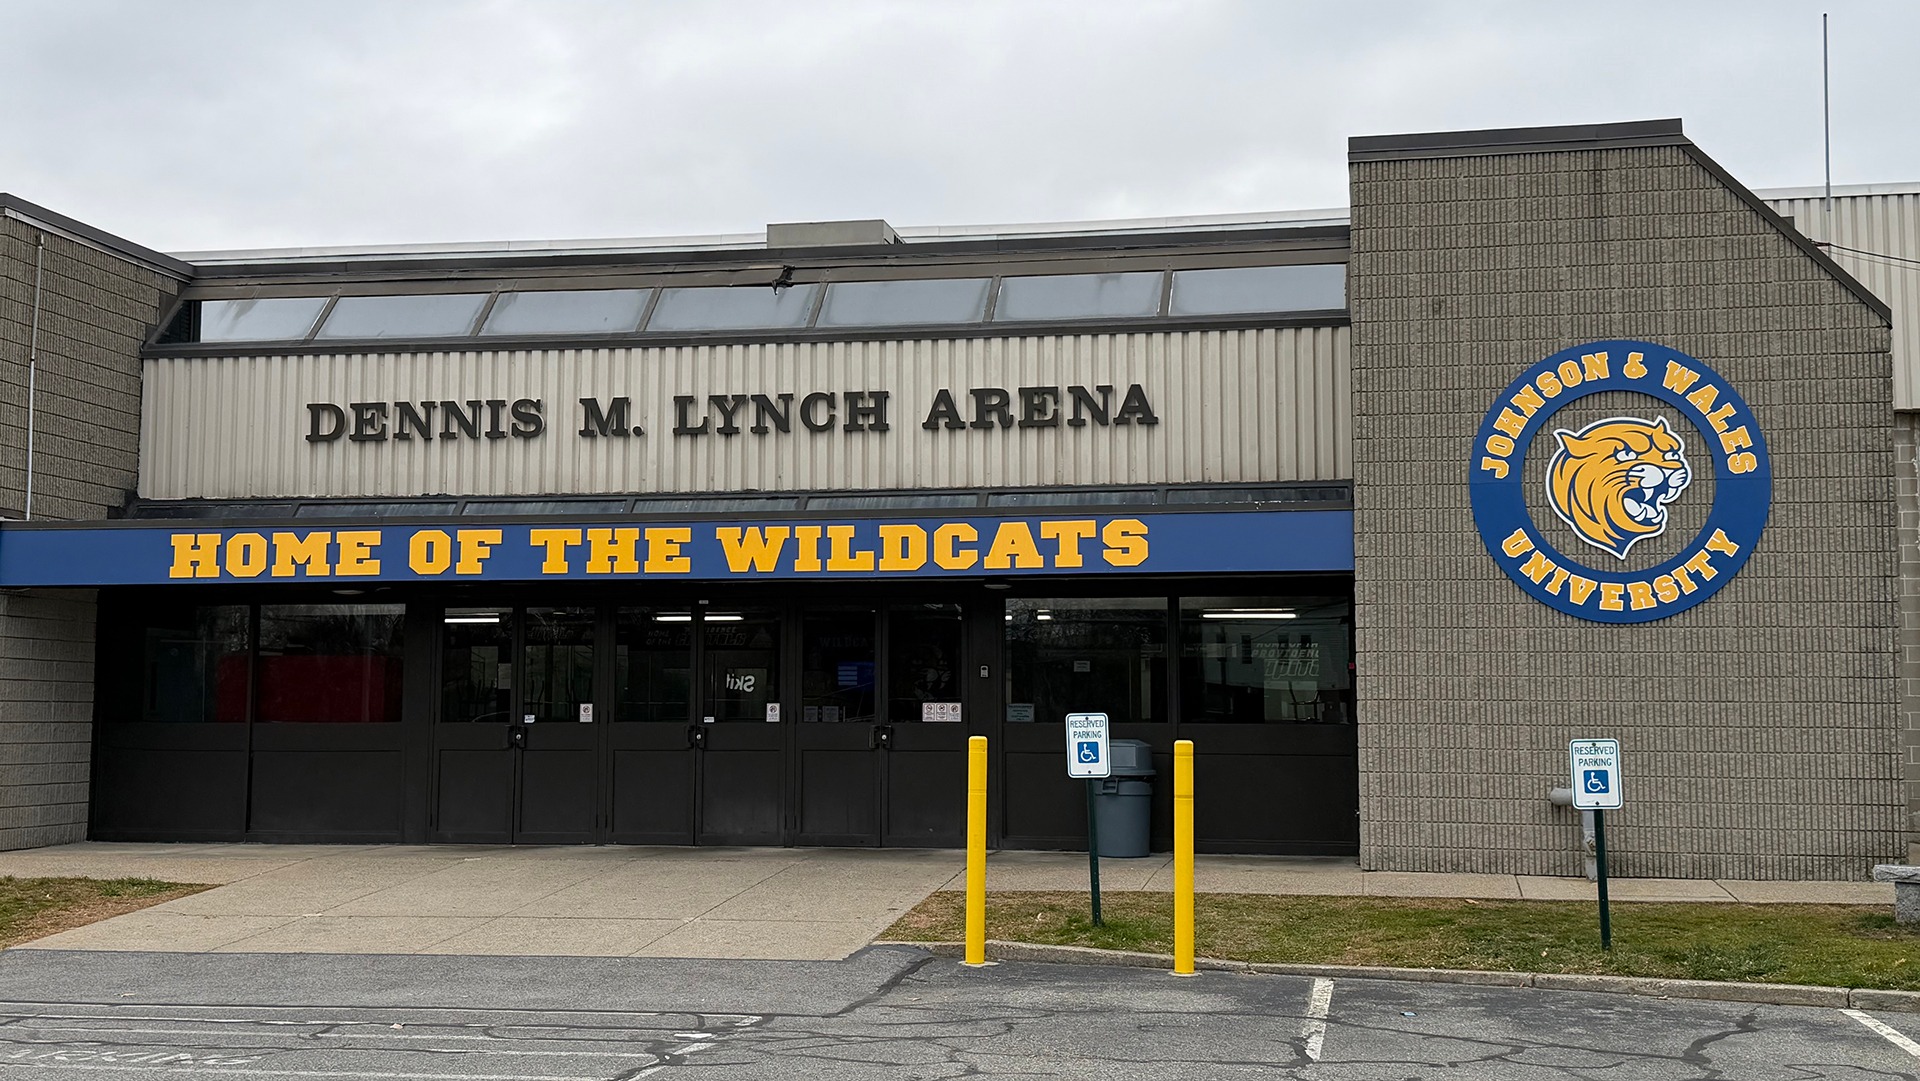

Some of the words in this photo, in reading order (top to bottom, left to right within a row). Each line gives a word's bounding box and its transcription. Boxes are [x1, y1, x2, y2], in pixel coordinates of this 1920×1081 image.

[305, 398, 547, 442] DENNIS
[578, 396, 646, 437] M.
[672, 390, 891, 436] LYNCH
[921, 383, 1159, 430] ARENA
[1481, 352, 1610, 479] JOHNSON
[1623, 352, 1648, 380] &
[1662, 360, 1758, 475] WALES
[169, 529, 382, 579] HOME
[408, 528, 503, 575] OF
[530, 527, 692, 574] THE
[715, 519, 1150, 573] WILDCATS
[1501, 528, 1740, 611] UNIVERSITY
[1070, 719, 1105, 728] RESERVED
[1073, 730, 1102, 739] PARKING
[1574, 746, 1615, 755] RESERVED
[1578, 758, 1612, 767] PARKING
